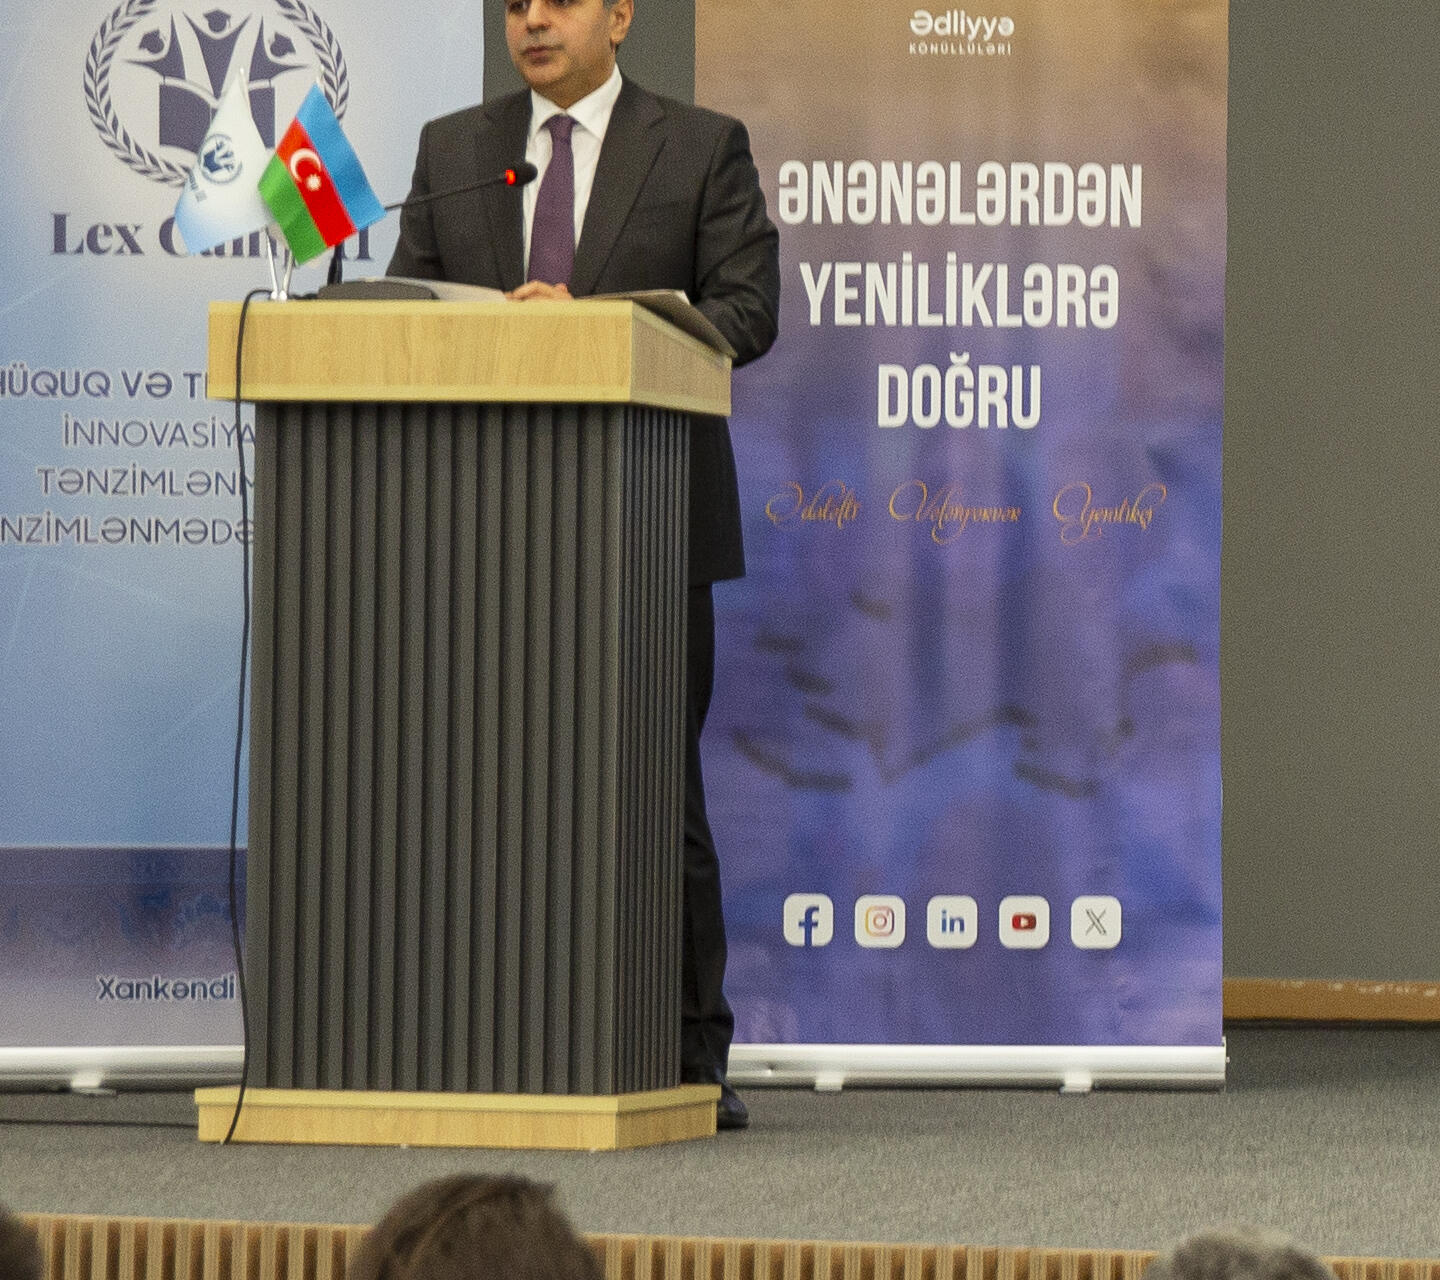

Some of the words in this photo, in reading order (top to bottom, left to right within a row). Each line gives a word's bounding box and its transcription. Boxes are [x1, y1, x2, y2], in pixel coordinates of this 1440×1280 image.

[910, 10, 1014, 43] Ədliyyə
[778, 161, 1142, 227] ƏNƏNƏLƏRDƏN
[53, 213, 143, 255] Lex
[799, 251, 1119, 329] YENİLİKLƏRƏ
[122, 372, 172, 399] VƏ
[877, 352, 1041, 429] DOĞRU
[99, 975, 235, 1000] Xankəndi
